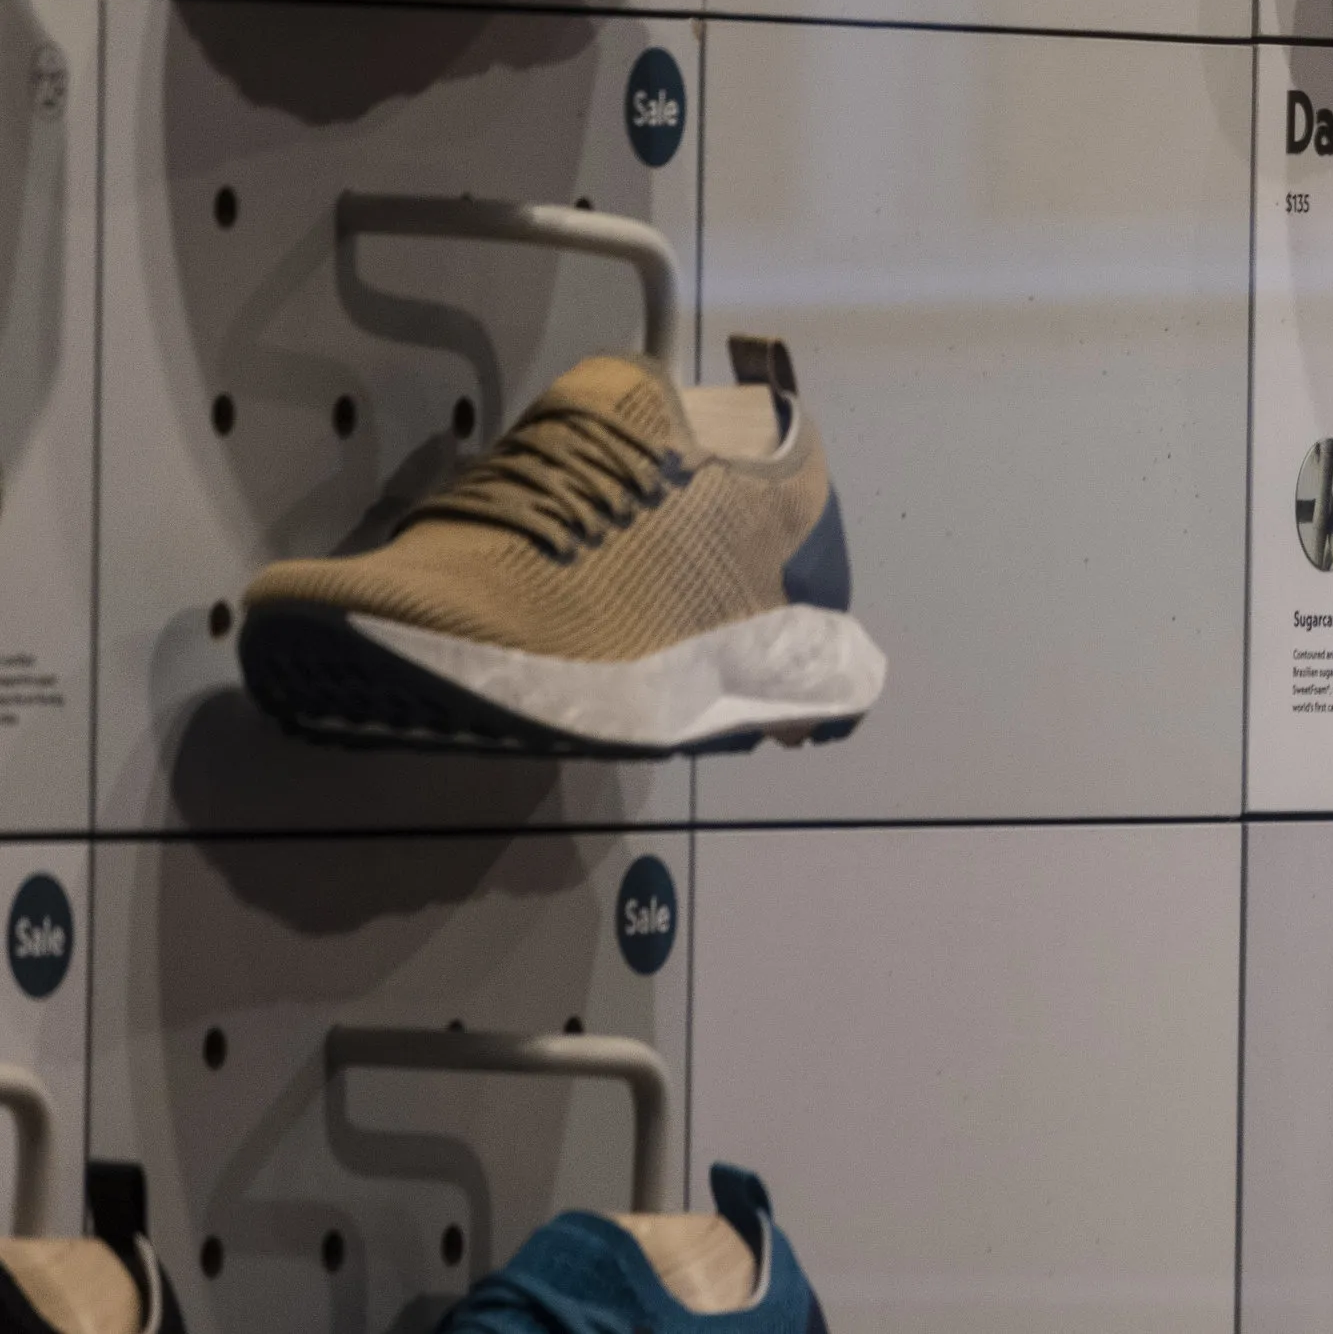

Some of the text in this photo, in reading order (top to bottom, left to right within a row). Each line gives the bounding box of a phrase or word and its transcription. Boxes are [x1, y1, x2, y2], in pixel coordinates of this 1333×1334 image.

[632, 88, 679, 126] Sale
[1285, 192, 1310, 214] $135
[624, 895, 671, 936] Sale
[14, 915, 66, 958] Sale
